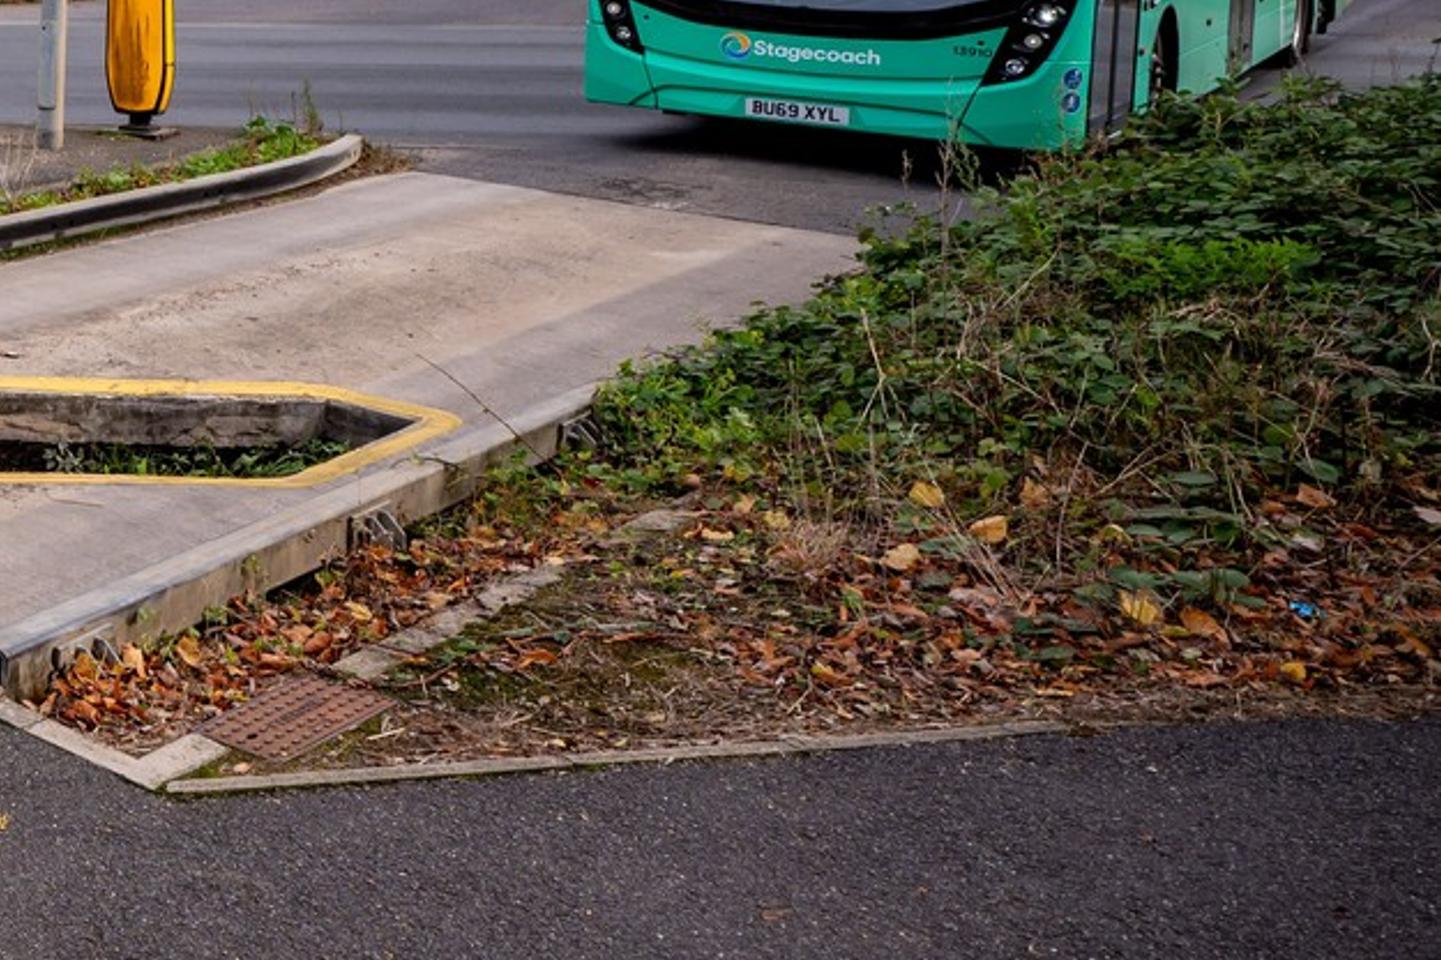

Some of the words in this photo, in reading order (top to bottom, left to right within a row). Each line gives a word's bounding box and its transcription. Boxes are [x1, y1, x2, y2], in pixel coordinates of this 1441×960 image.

[754, 39, 881, 66] Stagecoach
[752, 100, 799, 118] BU69
[805, 105, 840, 122] XYL
